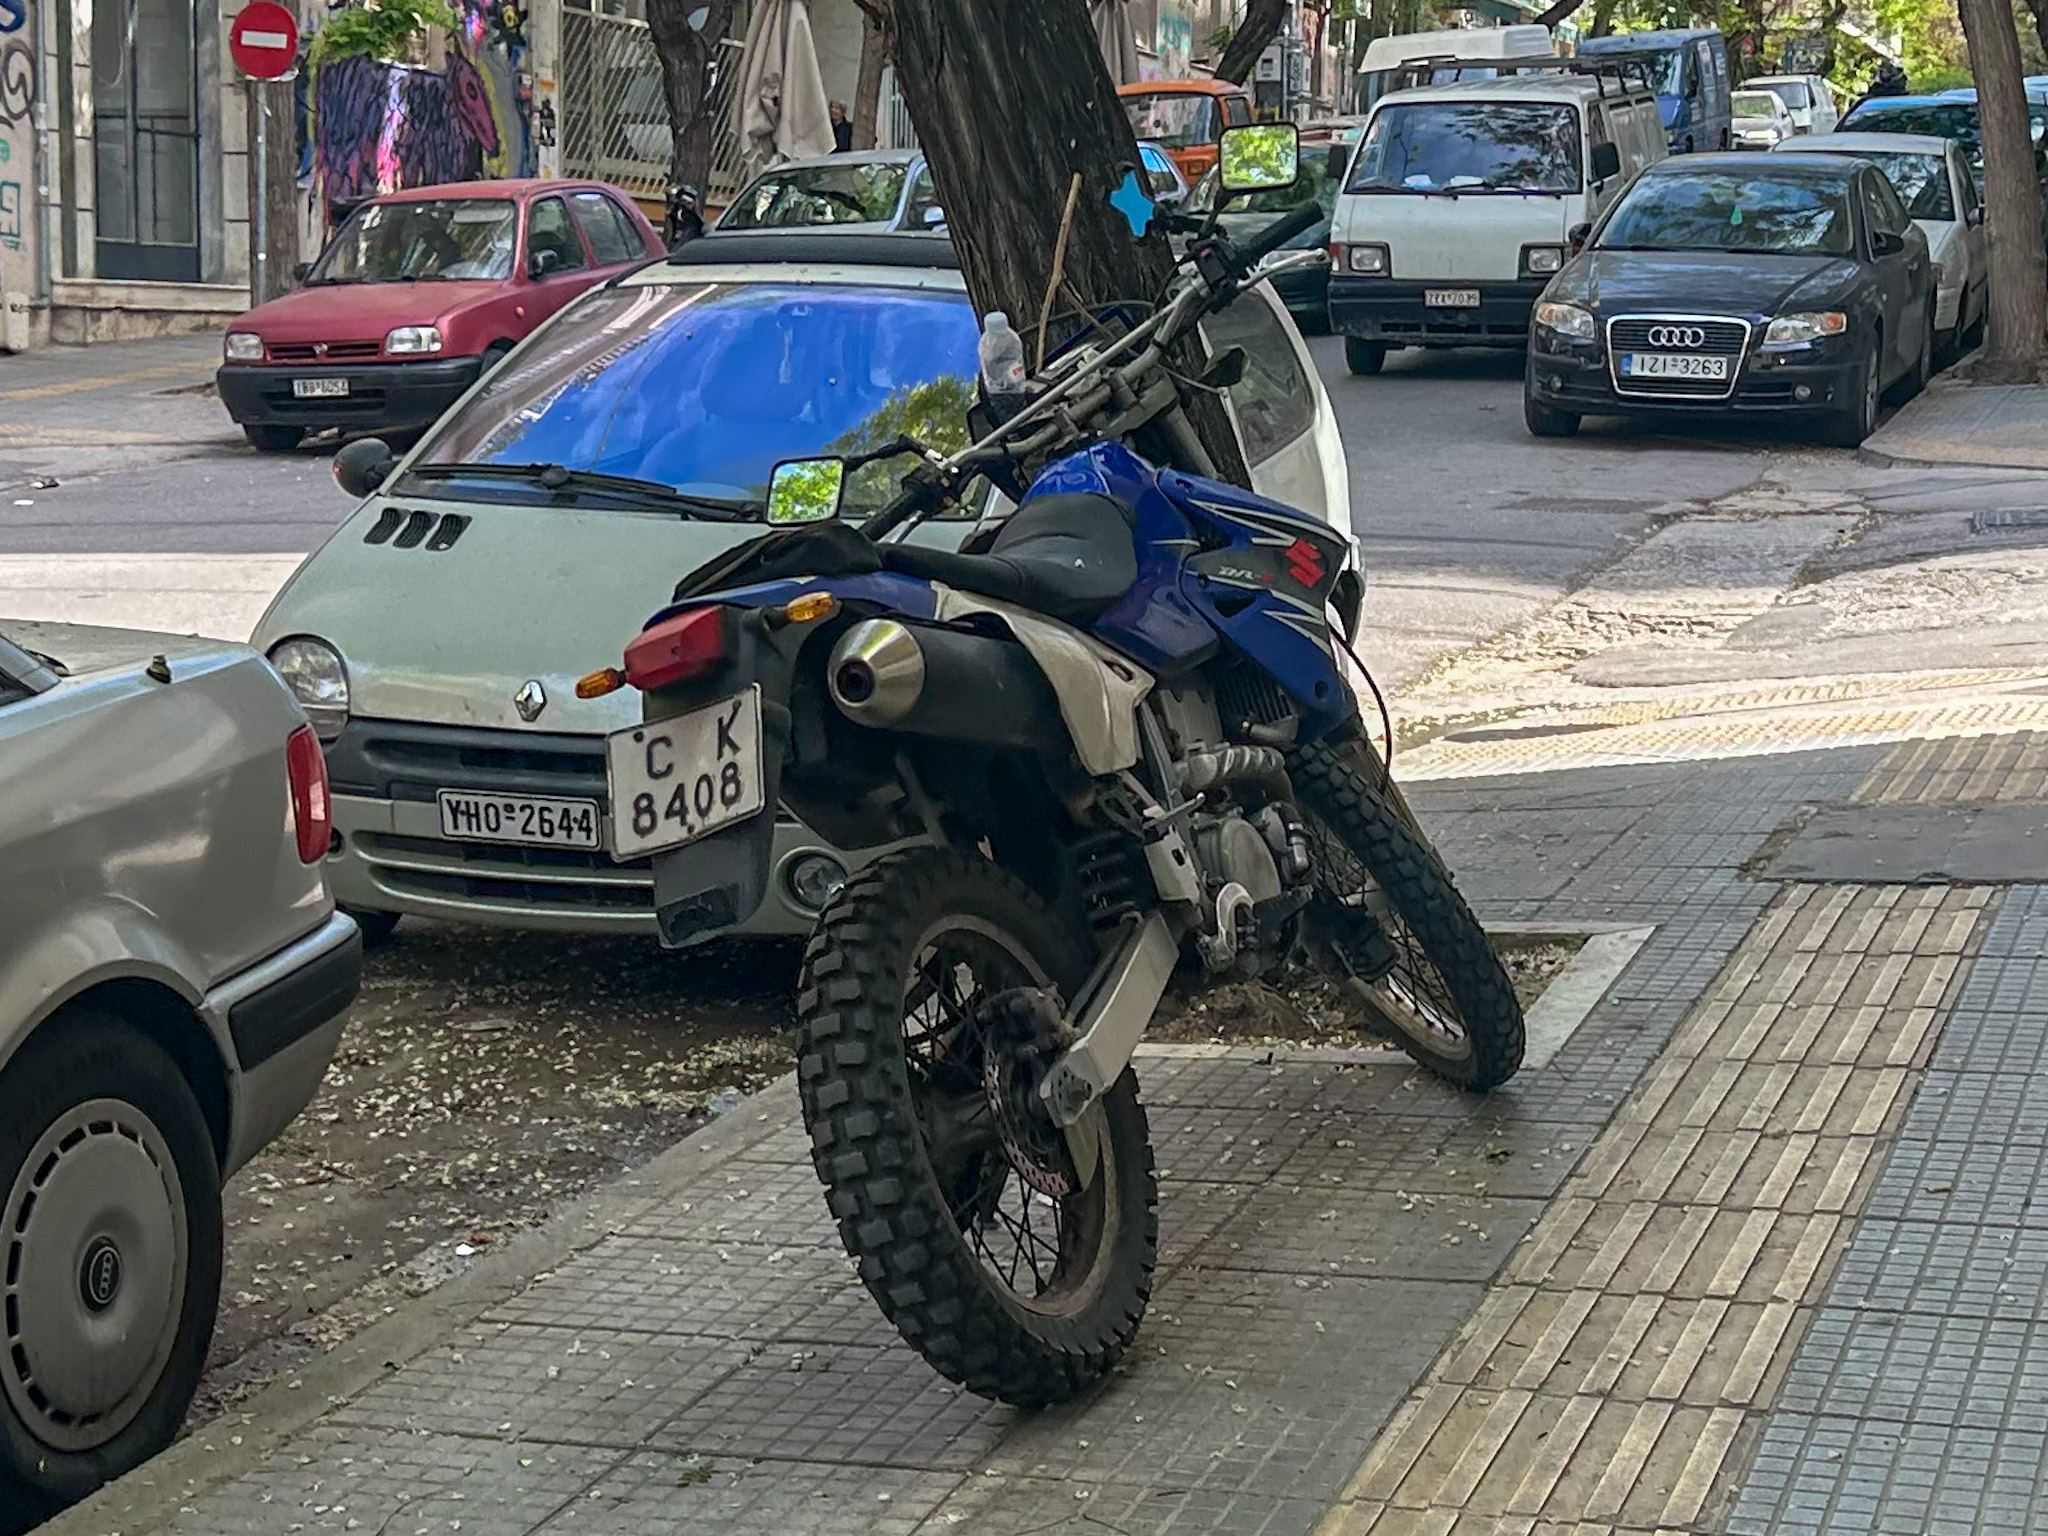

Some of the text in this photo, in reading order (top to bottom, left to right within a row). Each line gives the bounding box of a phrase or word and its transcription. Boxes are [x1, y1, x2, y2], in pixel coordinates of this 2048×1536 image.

[646, 700, 742, 780] C K
[632, 761, 742, 839] 8408
